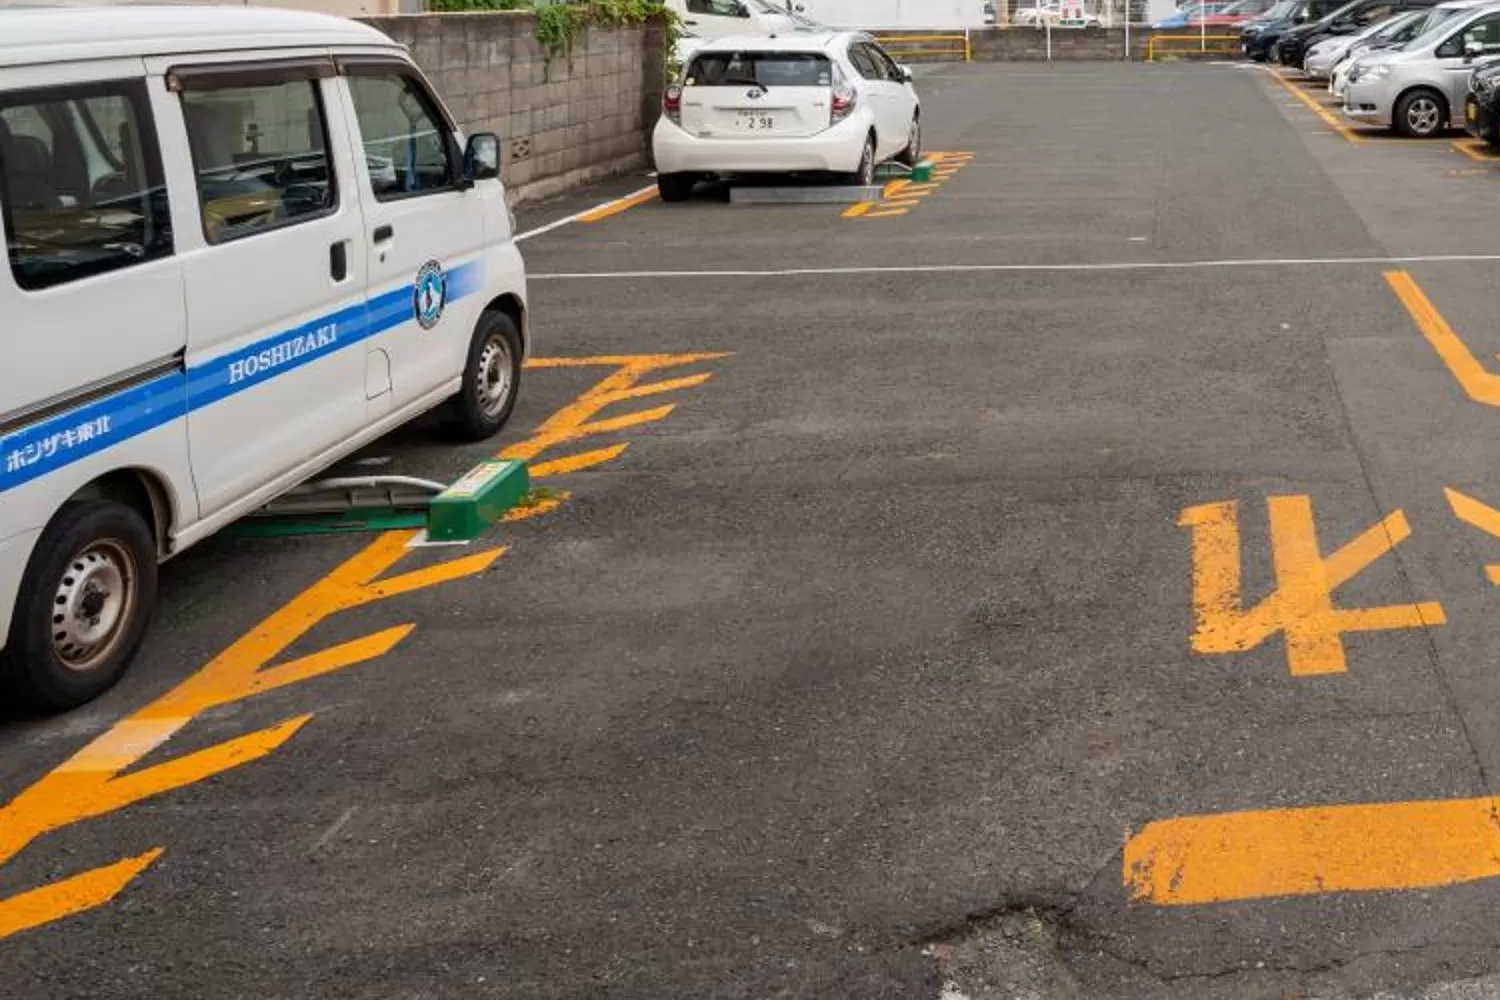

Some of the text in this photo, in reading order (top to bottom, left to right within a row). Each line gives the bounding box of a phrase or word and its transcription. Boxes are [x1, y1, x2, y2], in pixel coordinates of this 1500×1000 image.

[227, 323, 338, 385] HOSHIZAKI
[5, 414, 113, 473] ホシザキ東北
